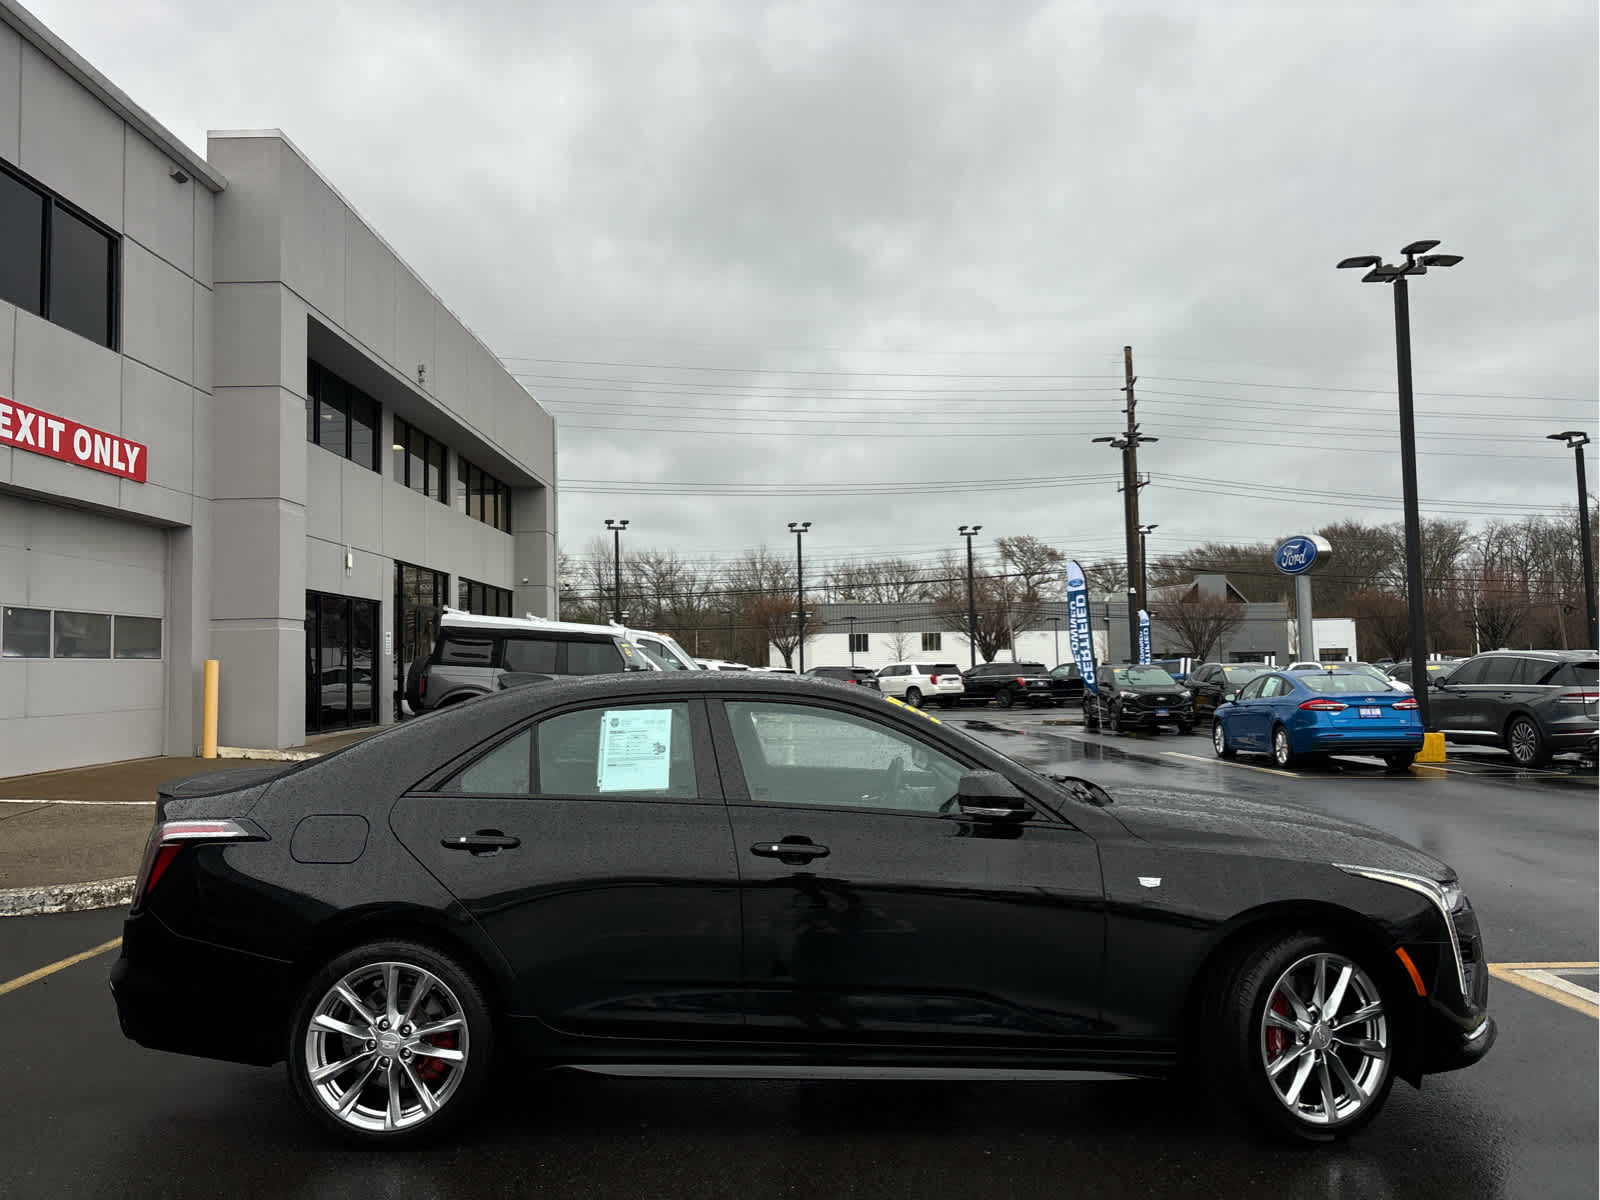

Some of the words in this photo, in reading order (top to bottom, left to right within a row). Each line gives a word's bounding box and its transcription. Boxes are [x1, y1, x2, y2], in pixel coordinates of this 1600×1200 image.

[0, 403, 65, 452] EXIT
[73, 428, 140, 473] ONLY
[1281, 544, 1307, 567] Ford
